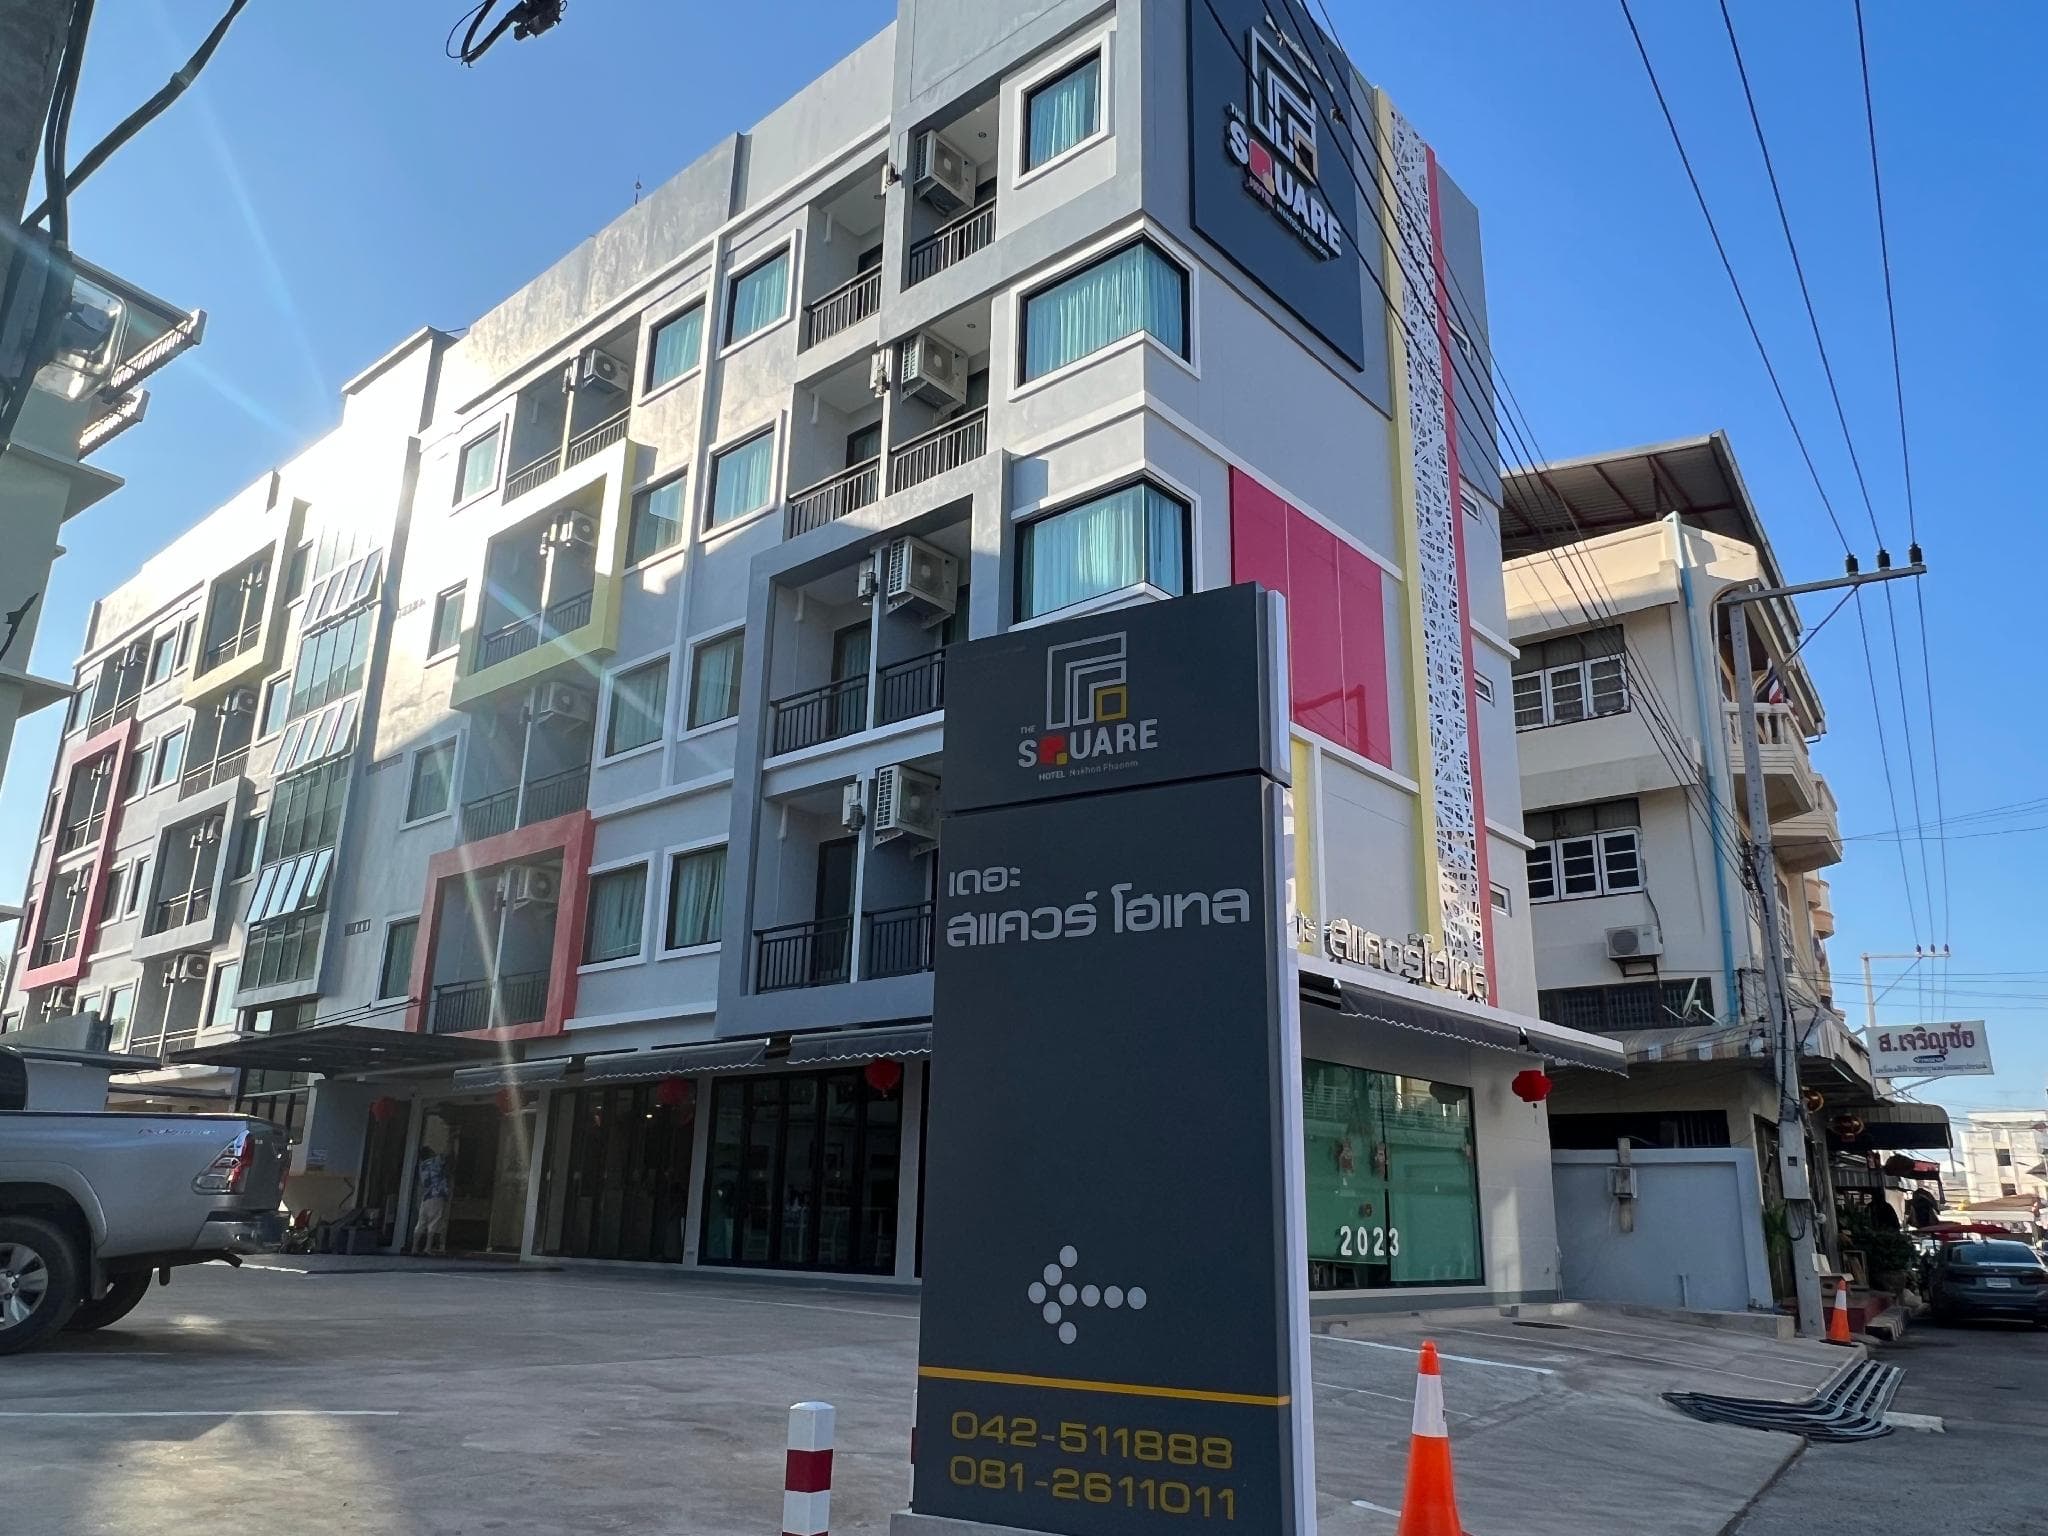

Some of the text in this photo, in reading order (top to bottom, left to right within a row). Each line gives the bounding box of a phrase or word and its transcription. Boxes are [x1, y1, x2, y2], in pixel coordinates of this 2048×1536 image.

[1021, 725, 1036, 735] THE
[1038, 770, 1066, 782] HOTEL
[949, 866, 1021, 897] เดอะ
[946, 890, 1098, 947] สแควร์
[1340, 1225, 1399, 1257] 2023
[951, 1411, 1233, 1470] 042-511888
[949, 1455, 1235, 1520] 081-2611011
